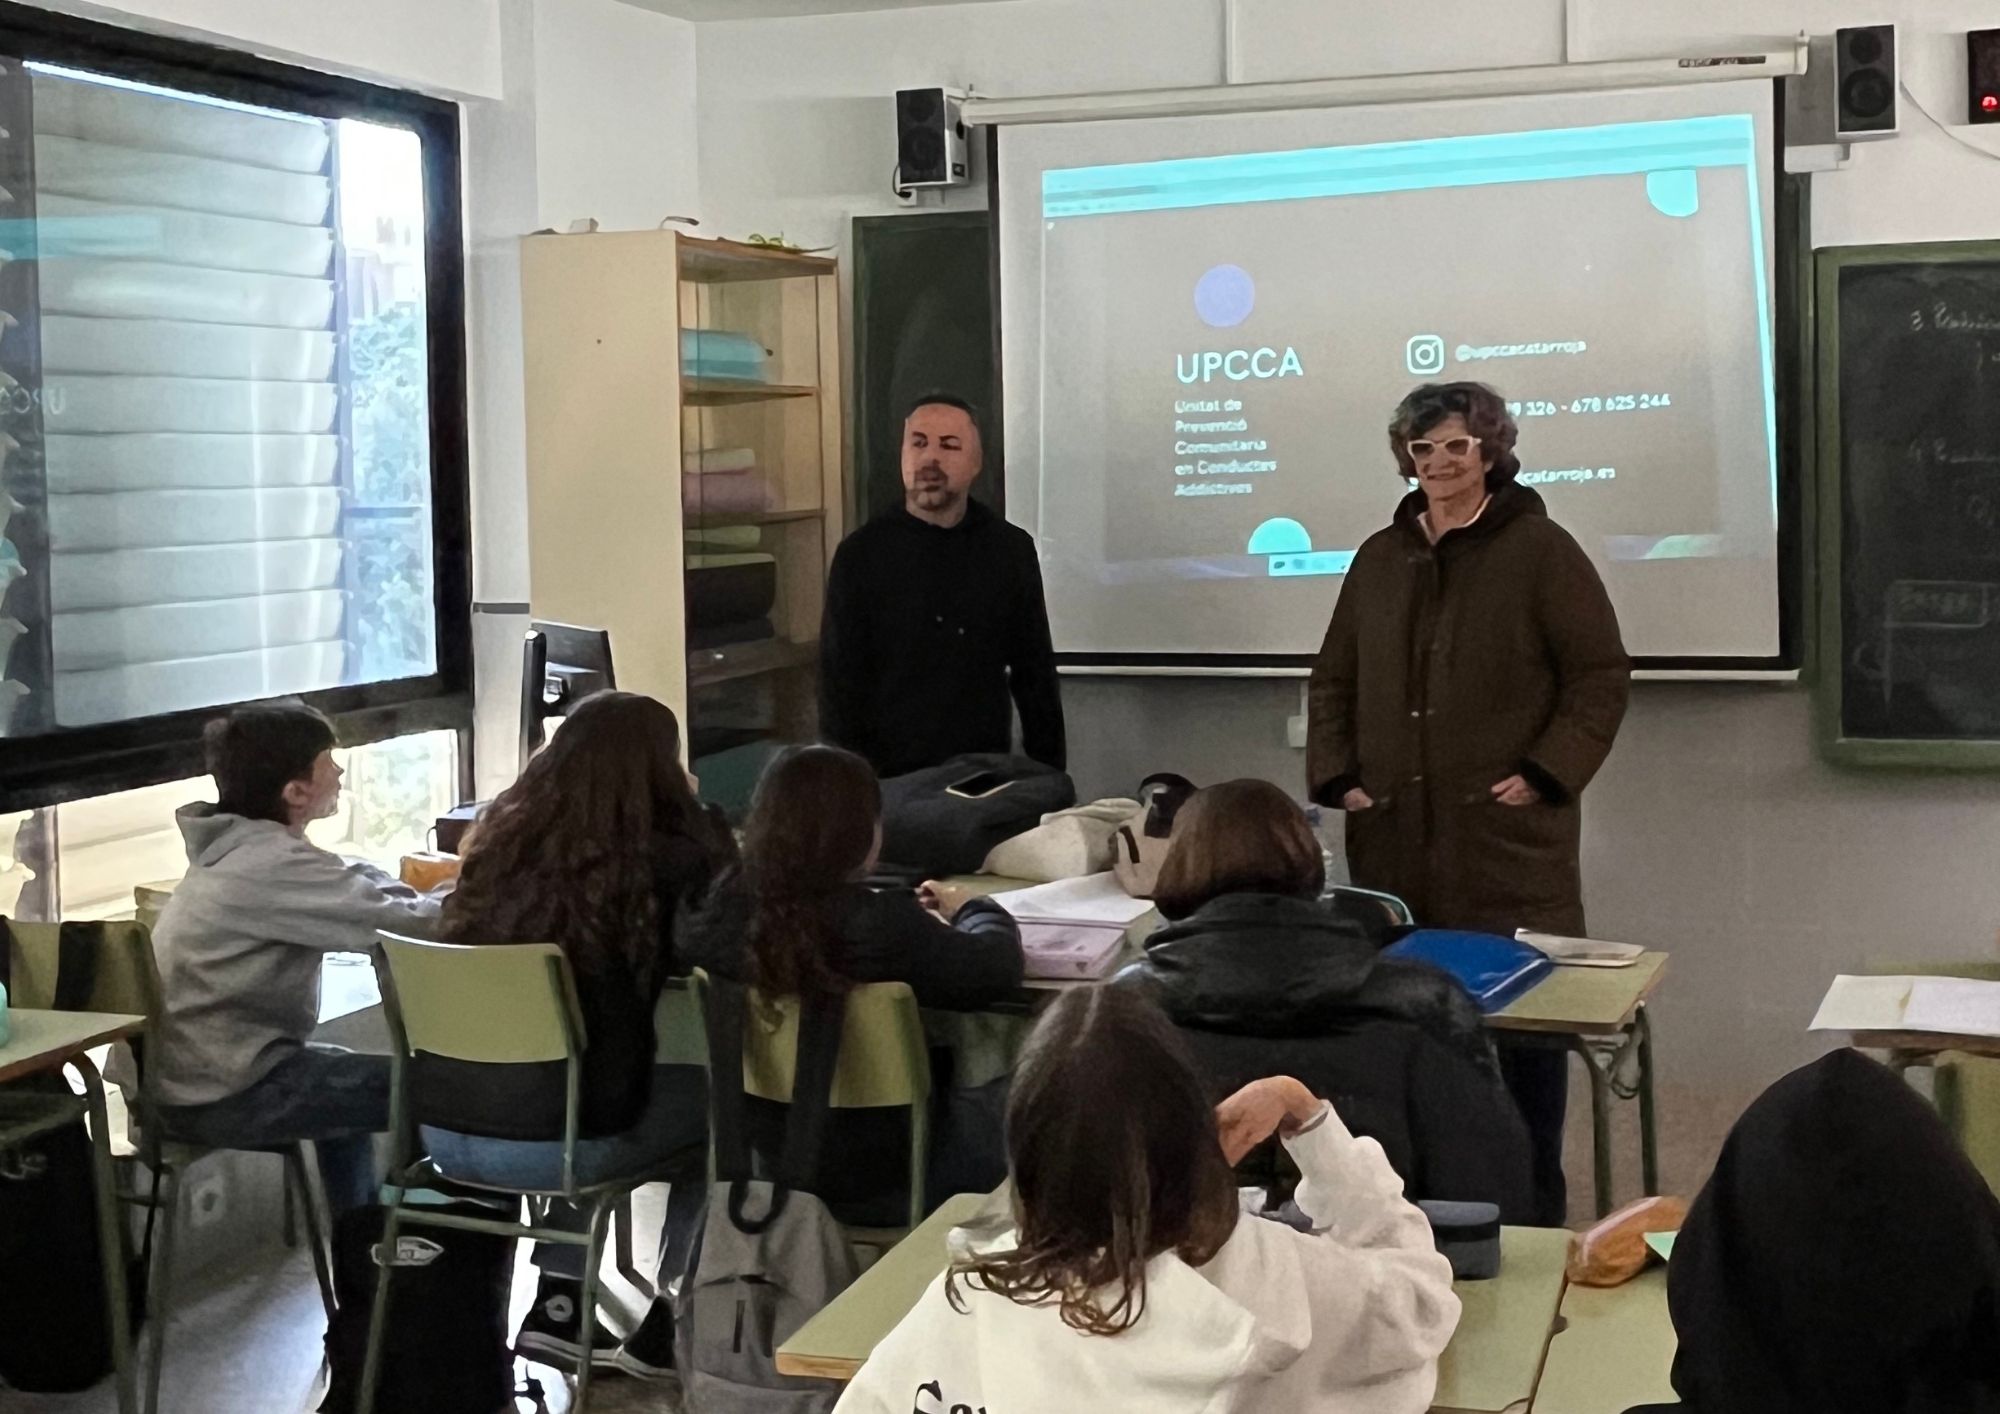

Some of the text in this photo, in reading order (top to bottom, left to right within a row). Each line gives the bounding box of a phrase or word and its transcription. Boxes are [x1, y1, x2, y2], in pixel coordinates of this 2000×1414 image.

[1176, 346, 1304, 384] UPCCA
[1223, 399, 1243, 412] de
[1174, 465, 1194, 476] en
